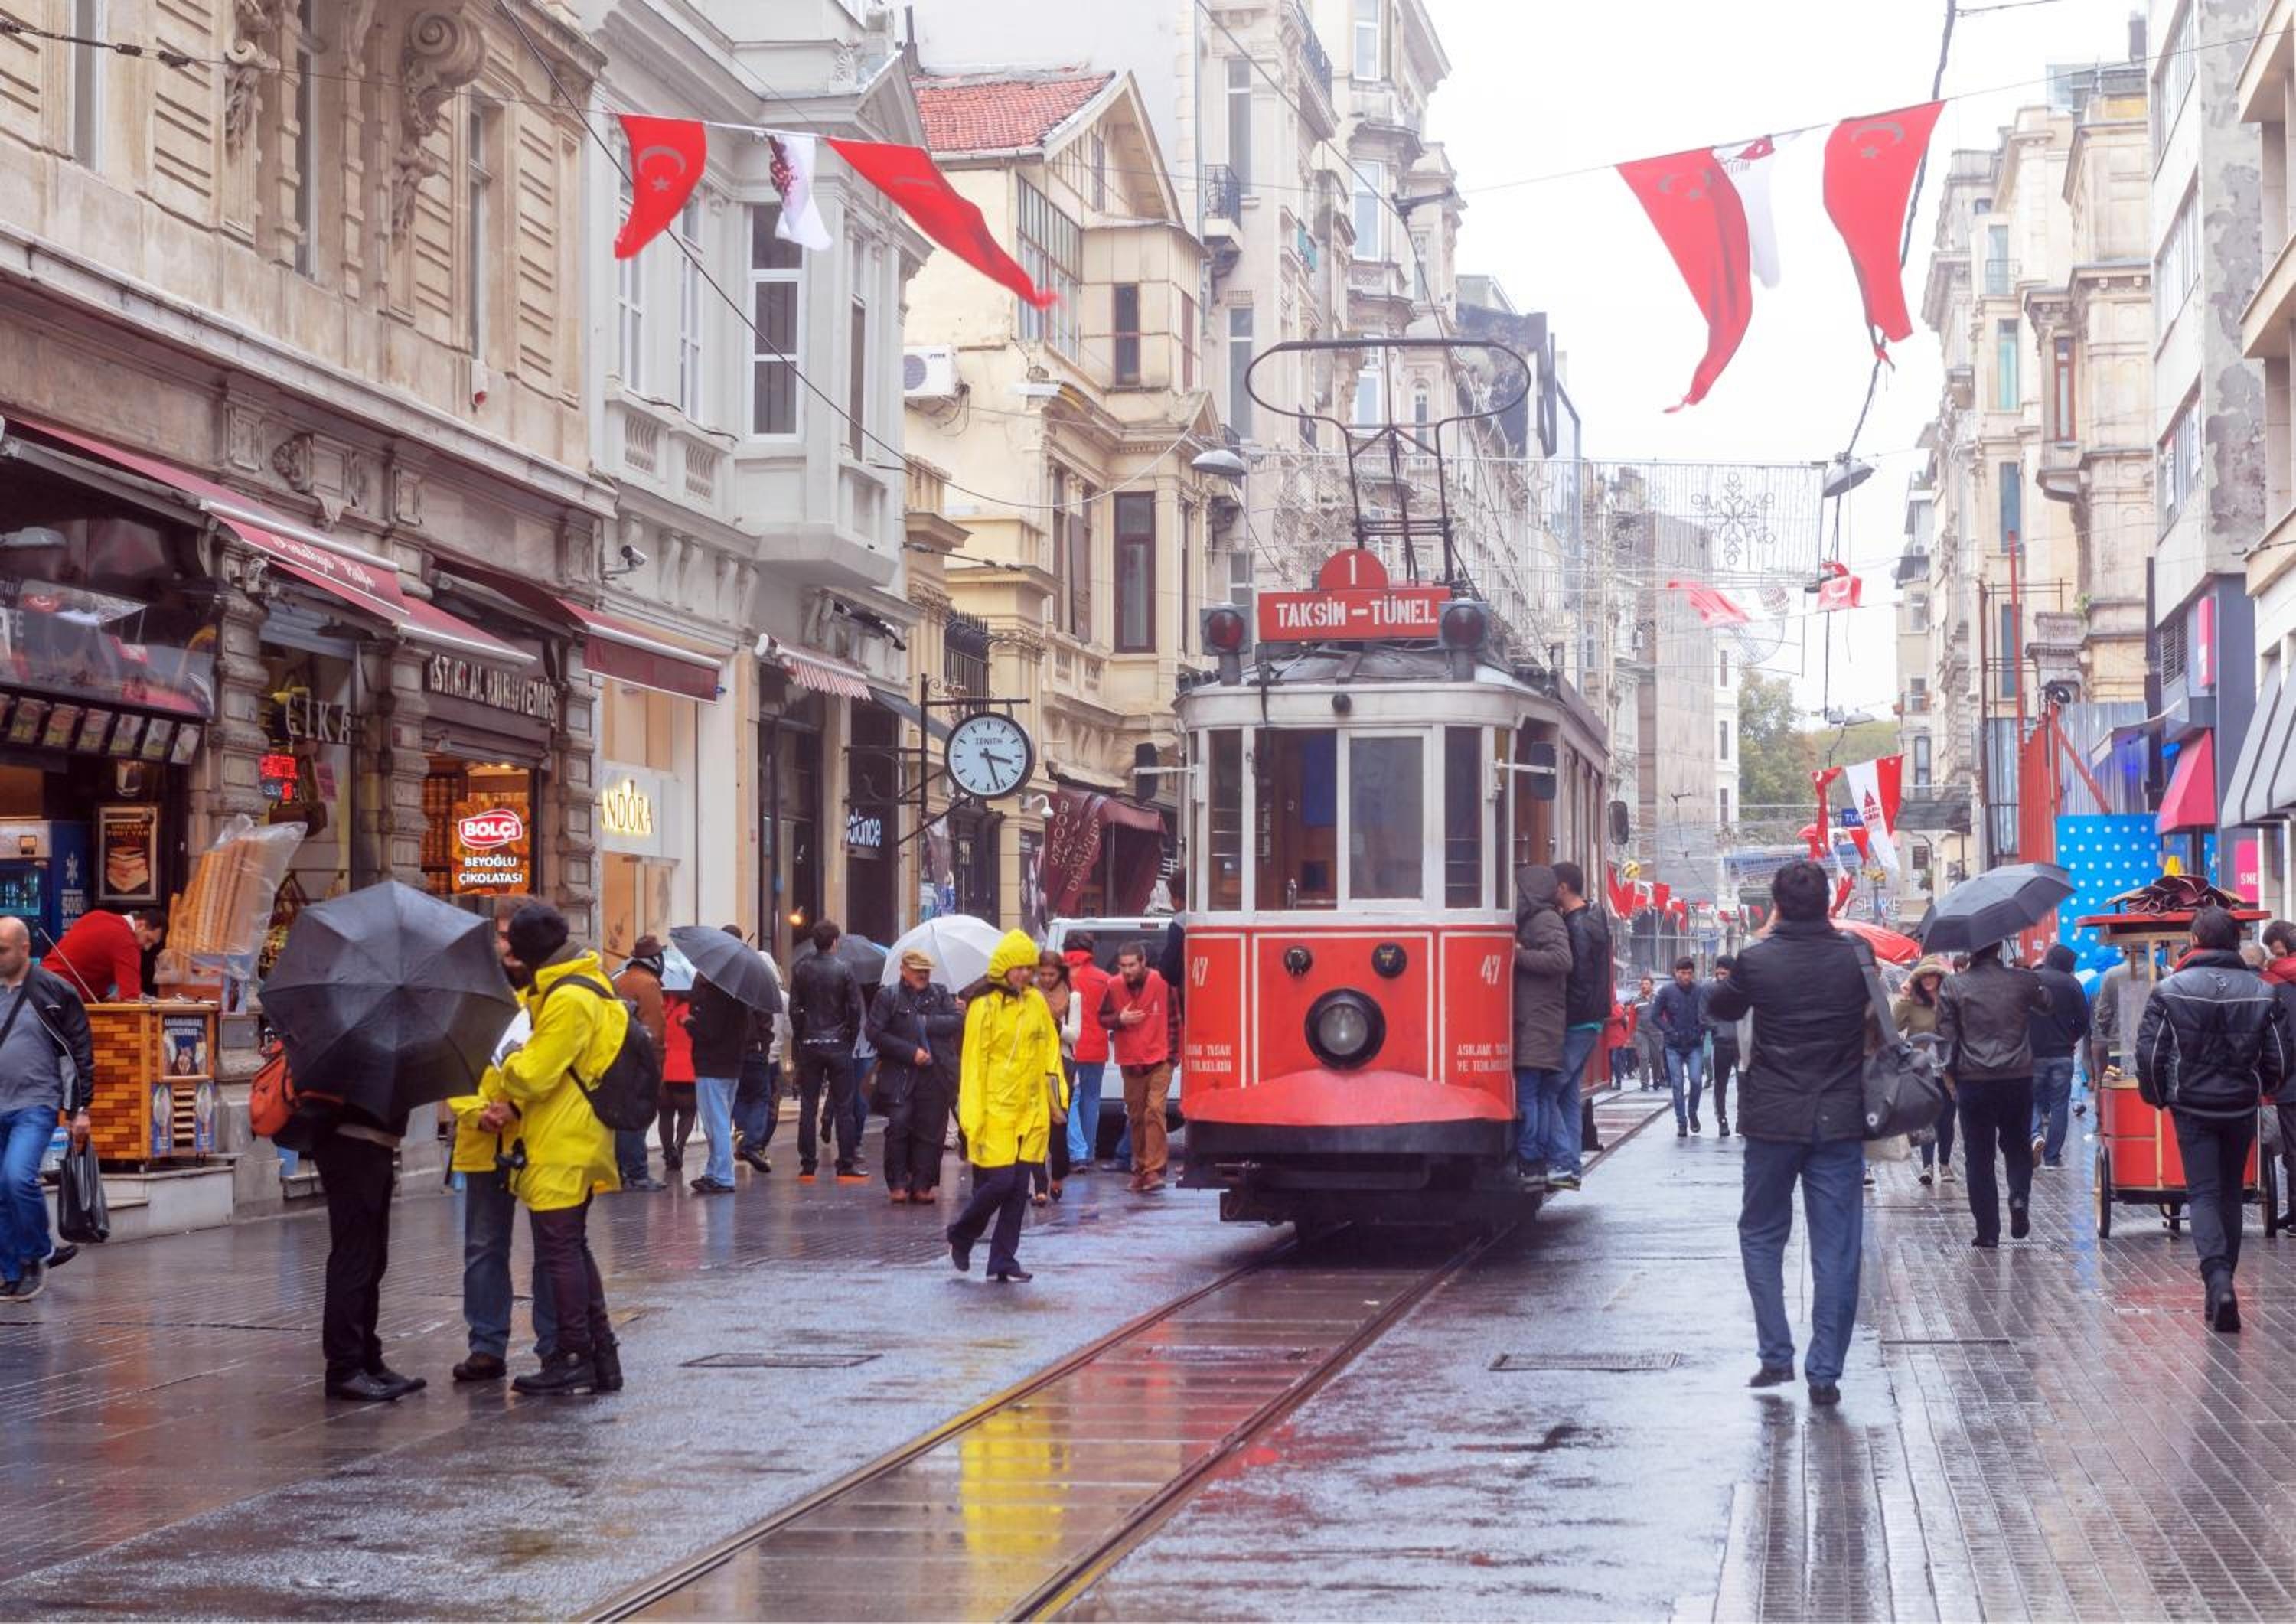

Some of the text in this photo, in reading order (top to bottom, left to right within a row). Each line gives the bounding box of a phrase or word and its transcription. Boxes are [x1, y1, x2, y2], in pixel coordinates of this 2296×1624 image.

[1348, 555, 1356, 585] 1
[1276, 596, 1346, 628] TAKSİM
[1370, 595, 1437, 625] TÜNEL
[601, 784, 655, 834] NDORA
[846, 807, 882, 847] alance
[1051, 800, 1070, 866] BOOKS
[465, 854, 517, 867] BEYOĞLU
[459, 871, 523, 885] ÇİKOLATASI
[1192, 957, 1208, 987] 47
[1481, 954, 1501, 986] 47
